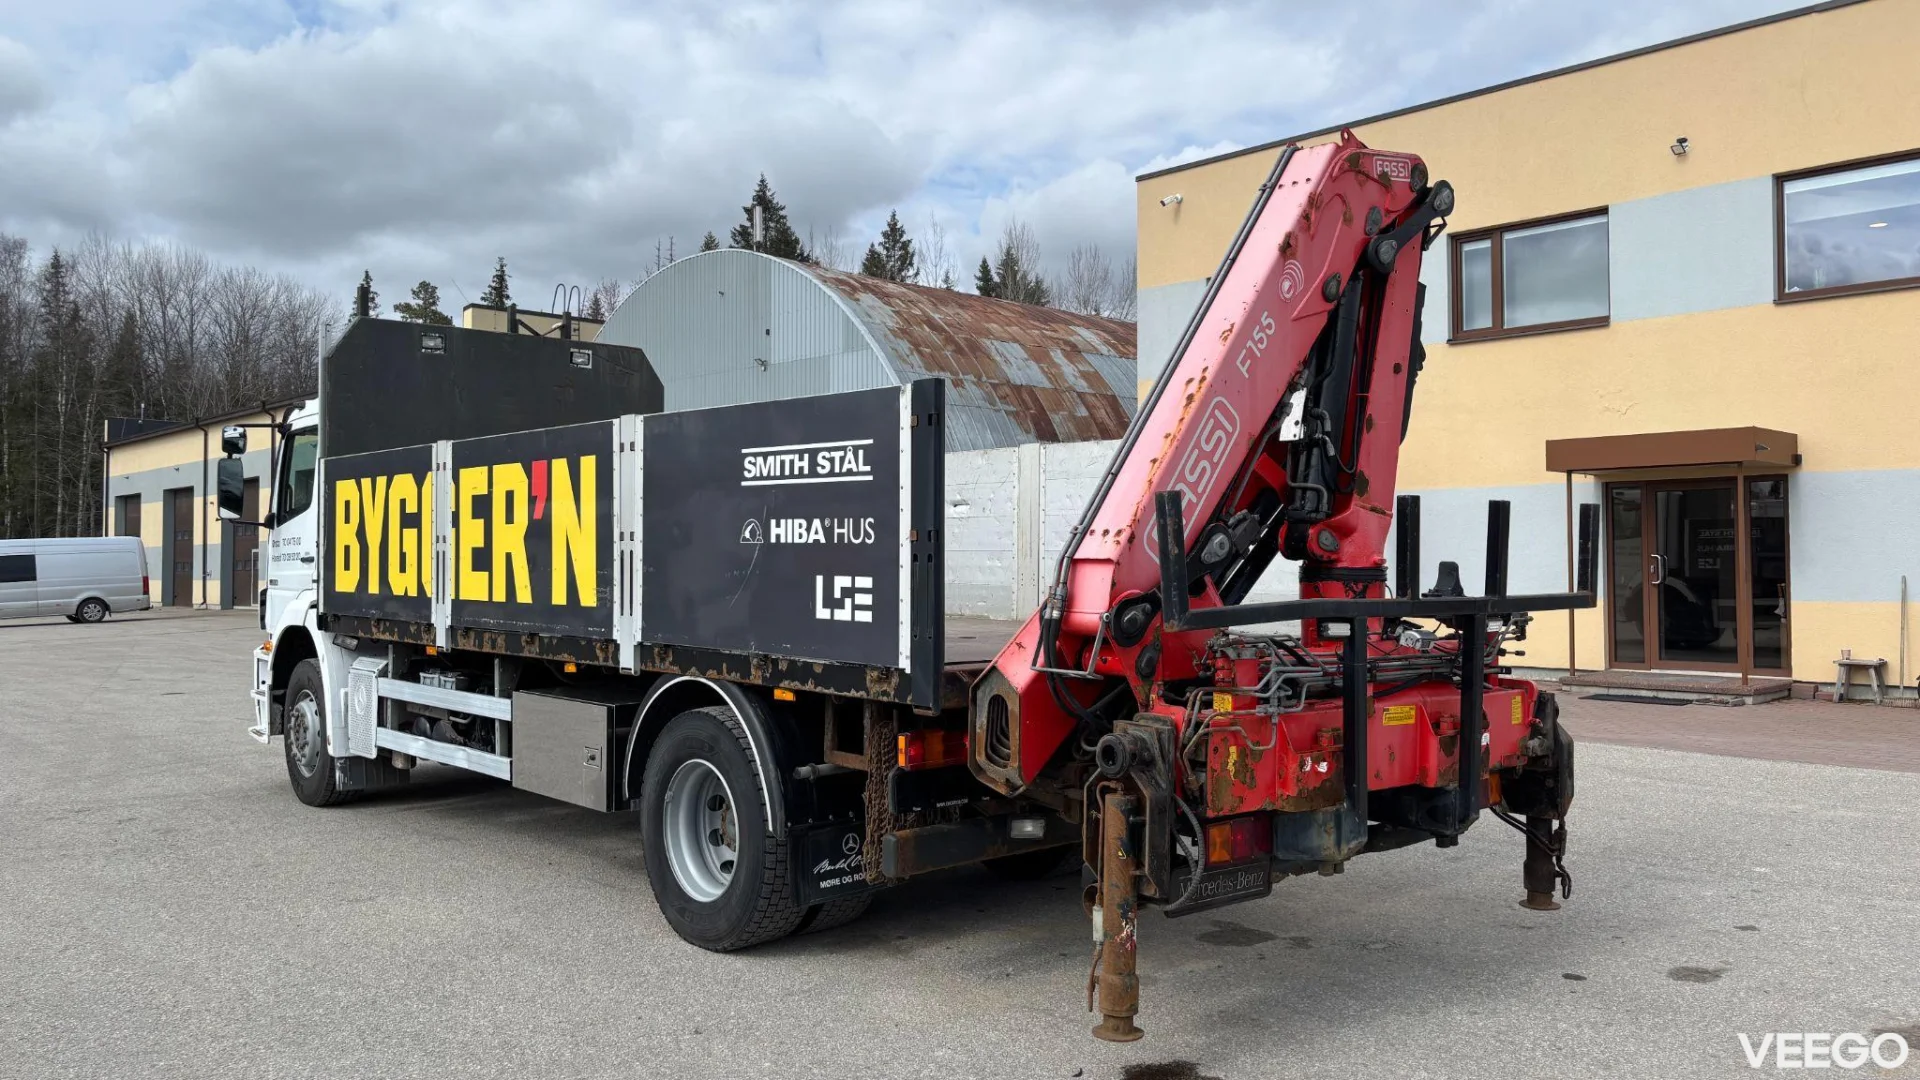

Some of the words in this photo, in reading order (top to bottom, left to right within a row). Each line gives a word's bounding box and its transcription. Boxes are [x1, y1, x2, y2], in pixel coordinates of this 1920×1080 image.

[1376, 160, 1409, 177] FASSI
[1236, 310, 1276, 379] F155
[743, 453, 809, 478] SMITH
[816, 446, 871, 474] STÅL
[1152, 408, 1233, 543] ASSI
[834, 517, 875, 545] HUS
[815, 574, 873, 623] LSE
[820, 877, 841, 889] MØRE
[841, 875, 853, 884] OG
[1179, 871, 1265, 899] Mrcedes-Benz
